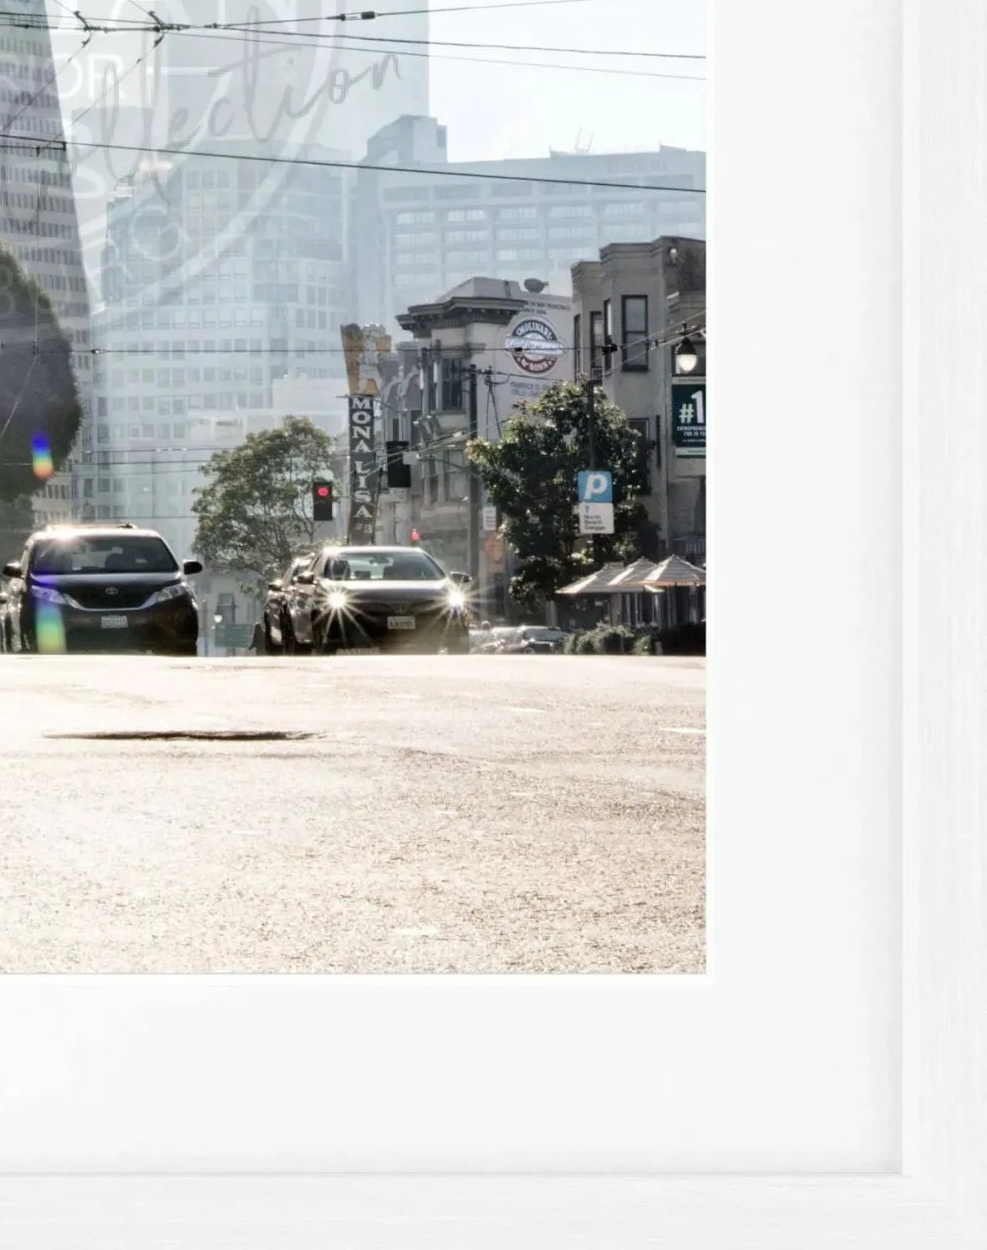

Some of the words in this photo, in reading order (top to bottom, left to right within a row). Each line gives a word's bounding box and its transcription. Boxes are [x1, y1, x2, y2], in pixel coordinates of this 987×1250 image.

[351, 397, 373, 453] MONA
[678, 389, 705, 424] #1
[353, 460, 373, 519] LISA
[584, 473, 608, 500] P
